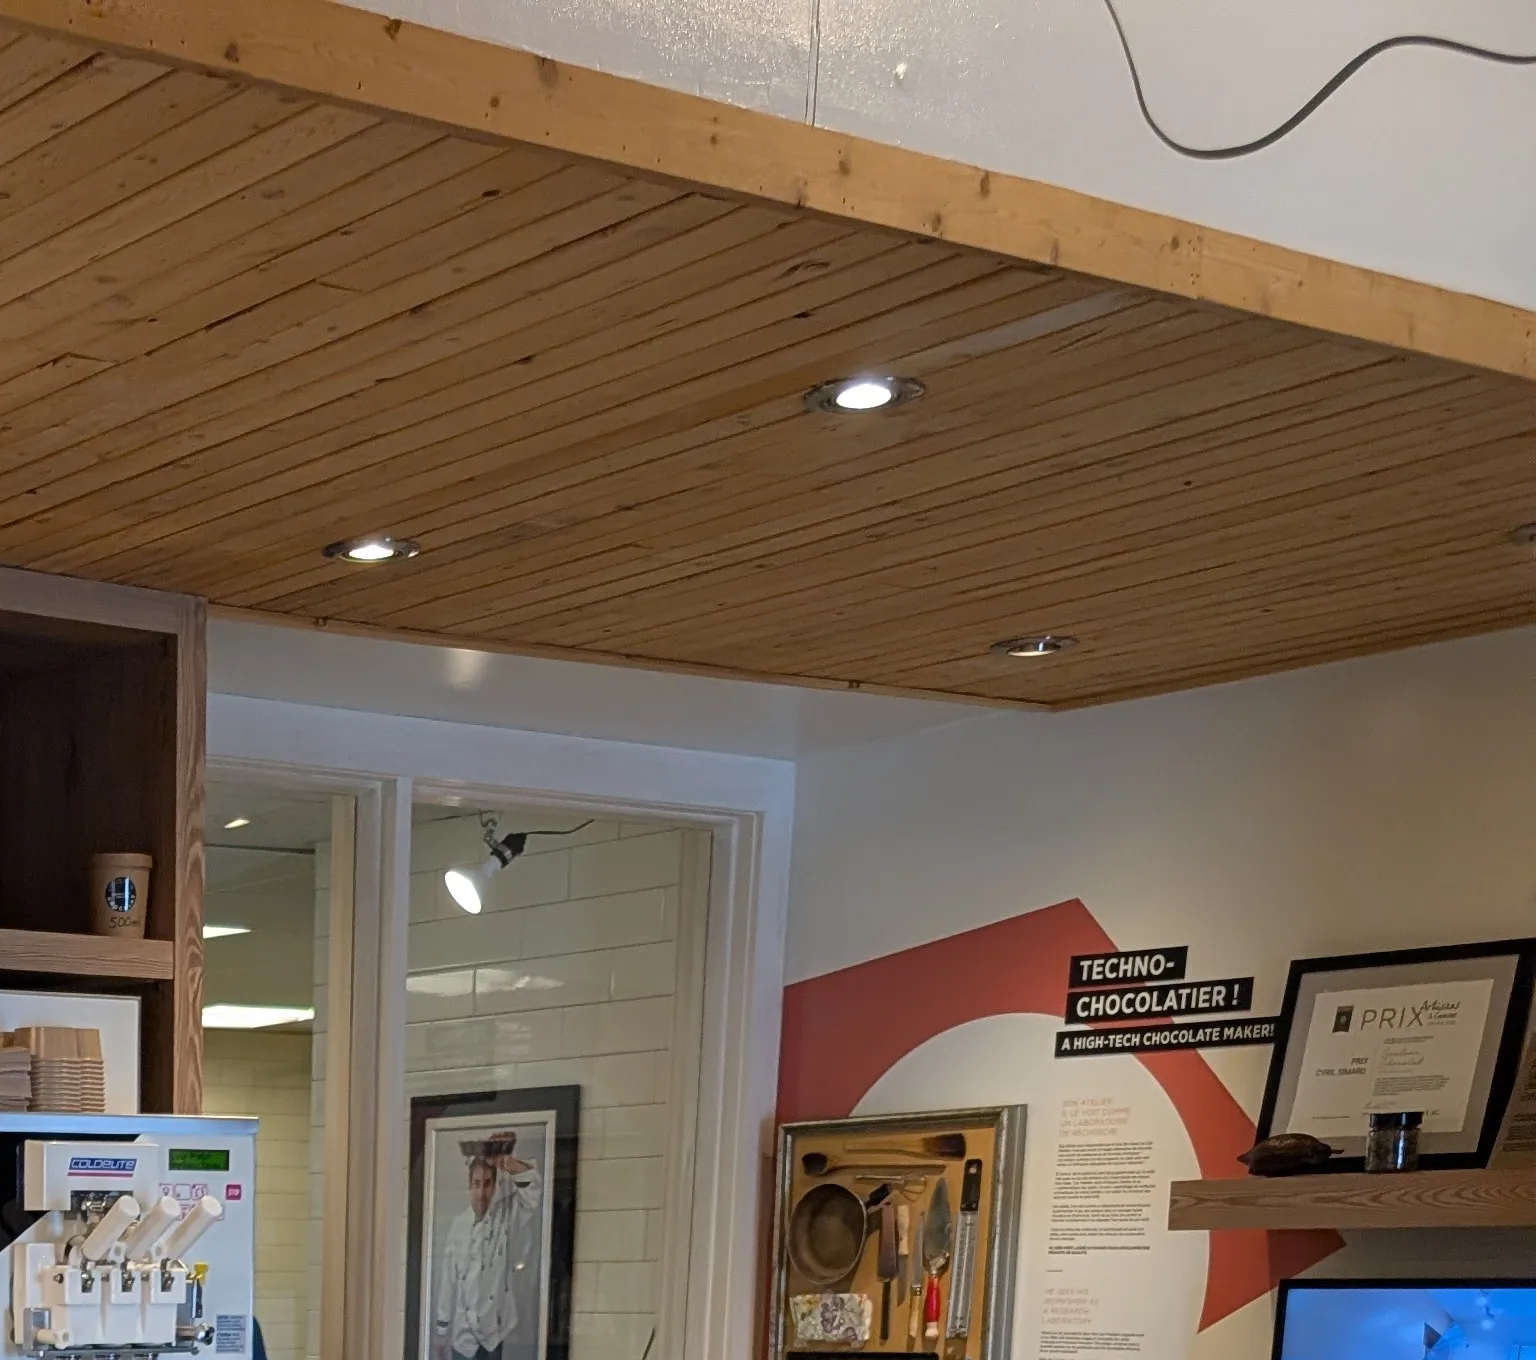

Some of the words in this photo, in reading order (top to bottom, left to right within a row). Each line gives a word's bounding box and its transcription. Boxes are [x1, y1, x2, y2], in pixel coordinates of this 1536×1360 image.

[1080, 954, 1174, 981] TECHNO-
[1076, 985, 1225, 1018] CHOCOLATIER
[1361, 1007, 1424, 1030] PRIX
[1061, 1038, 1071, 1050] A
[1073, 1034, 1140, 1050] HIGH-TECH
[1143, 1028, 1219, 1046] CHOCOLATE
[1223, 1024, 1275, 1040] MAKER!
